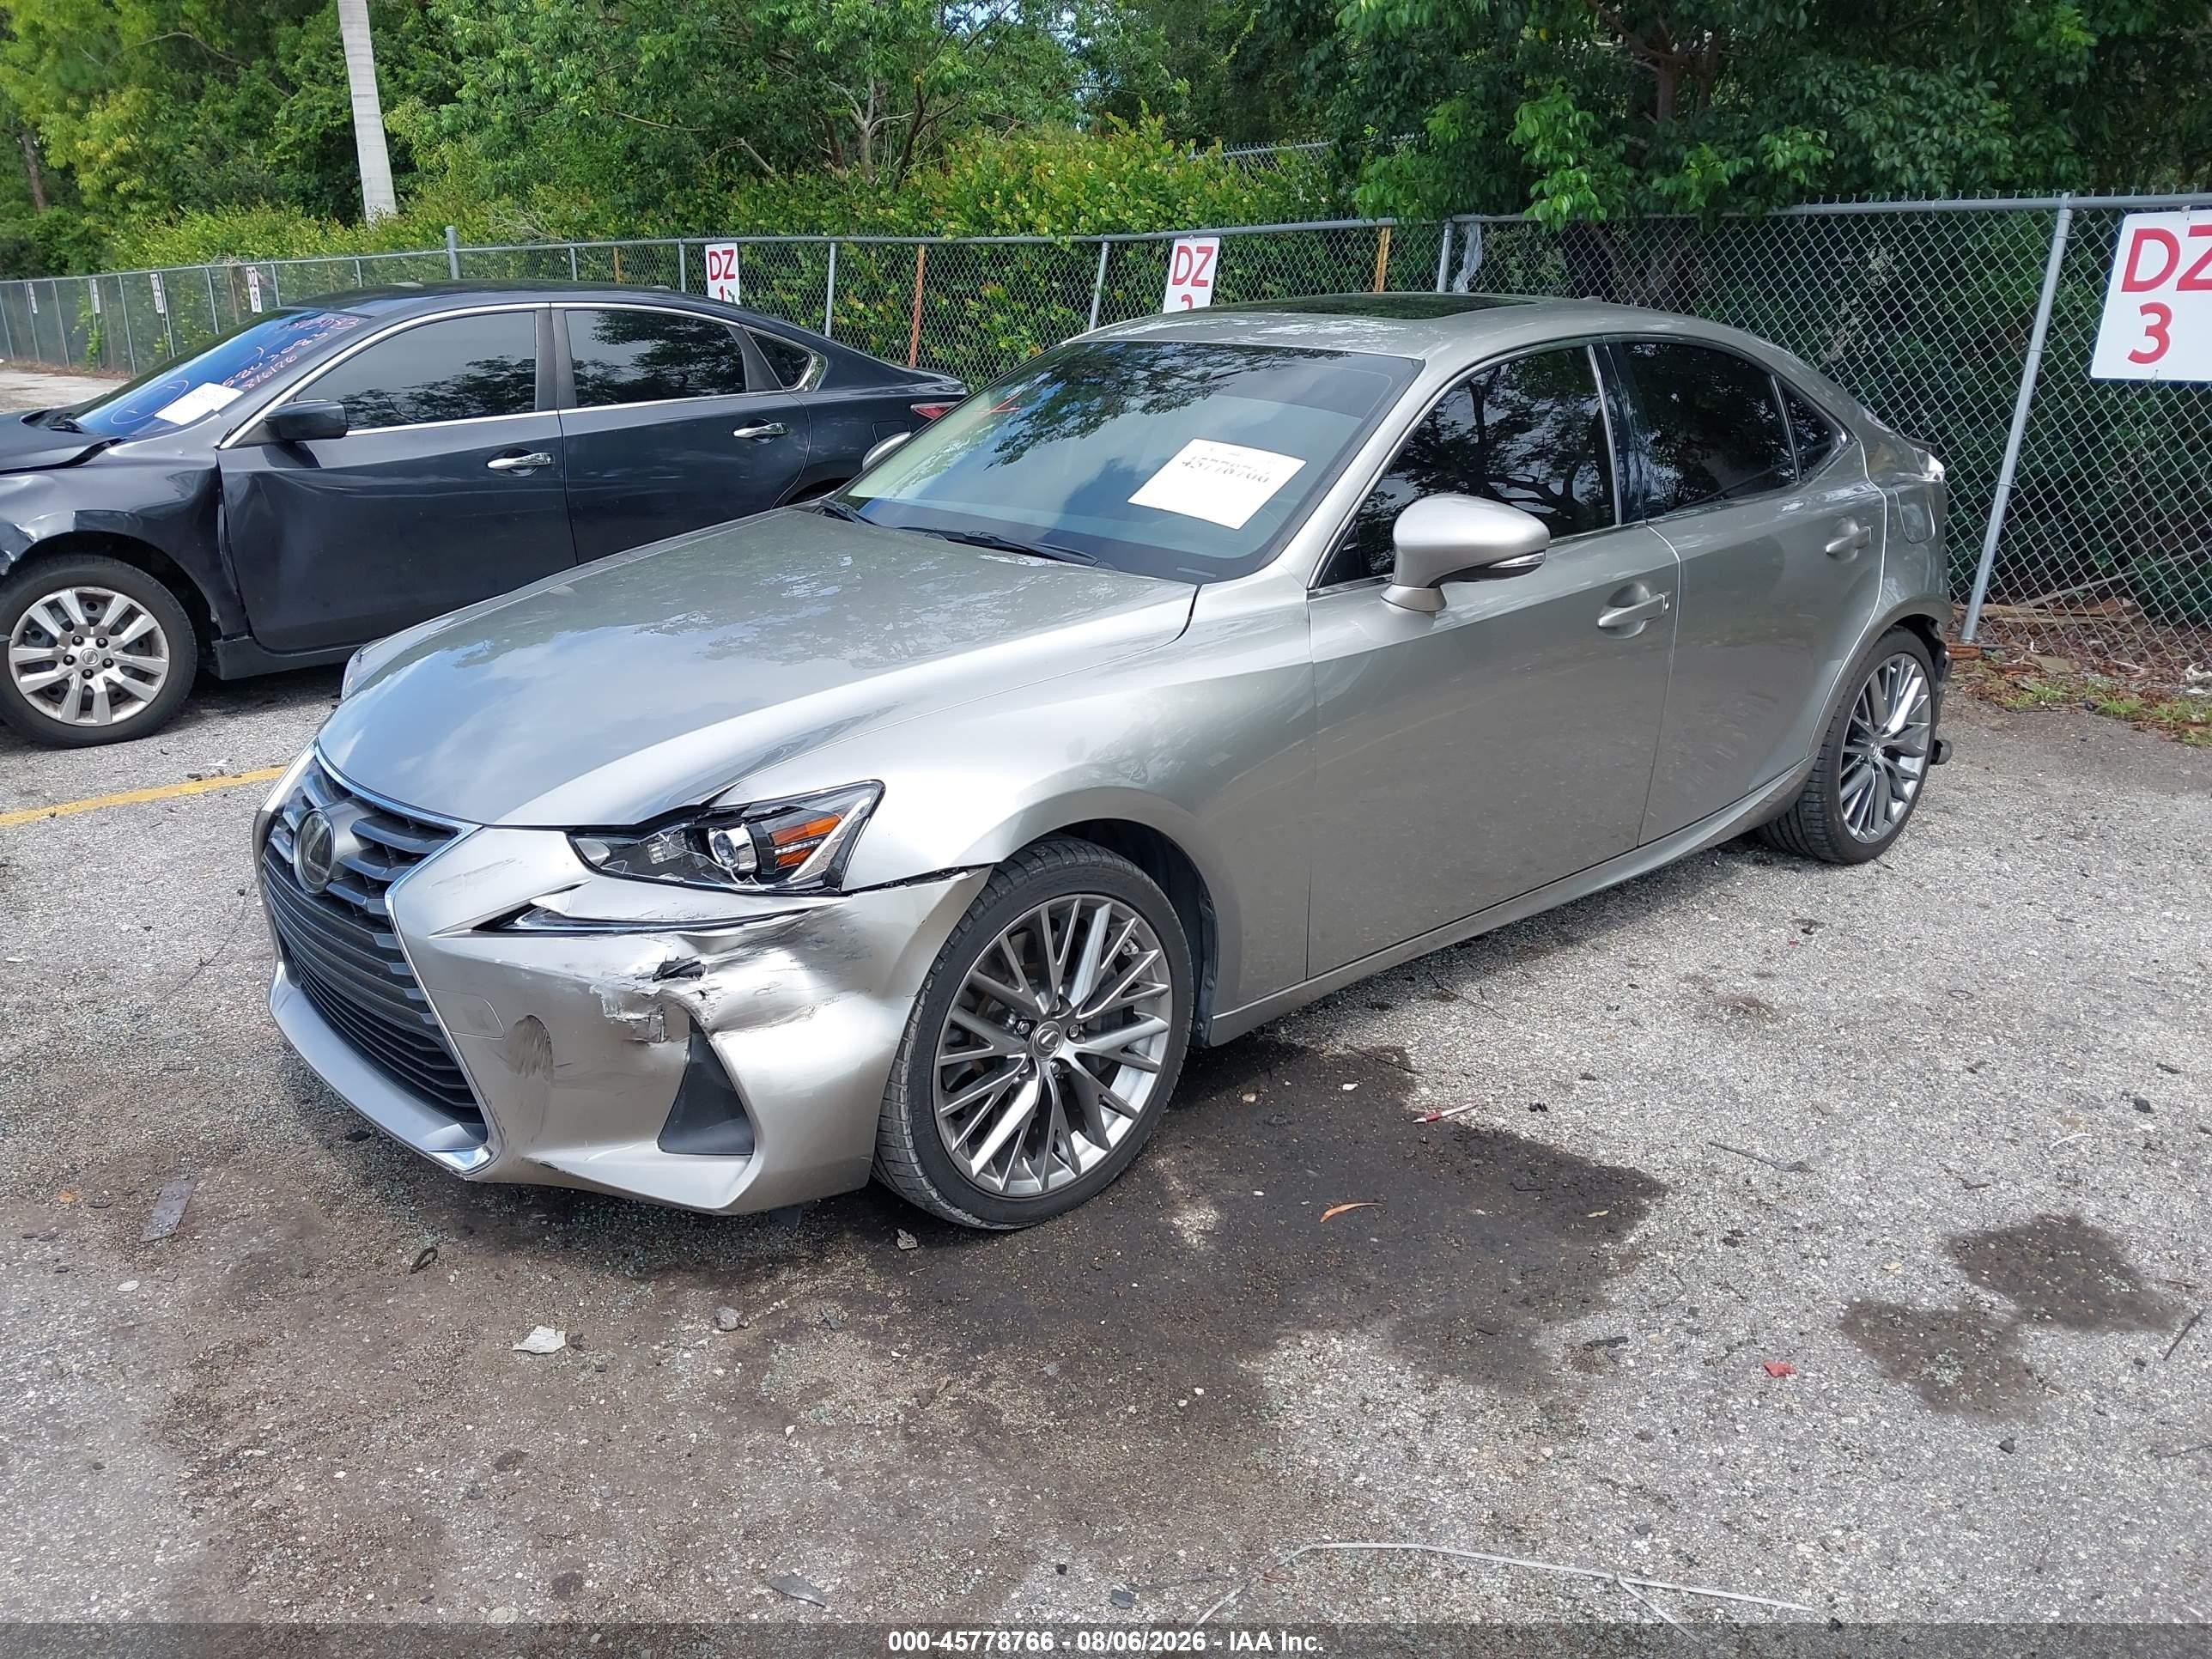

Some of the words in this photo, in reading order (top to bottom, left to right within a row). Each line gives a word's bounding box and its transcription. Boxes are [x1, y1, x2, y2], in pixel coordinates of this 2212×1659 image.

[247, 270, 258, 288] DZ
[708, 249, 736, 281] DZ
[1171, 246, 1214, 288] DZ
[2127, 301, 2172, 364] 3
